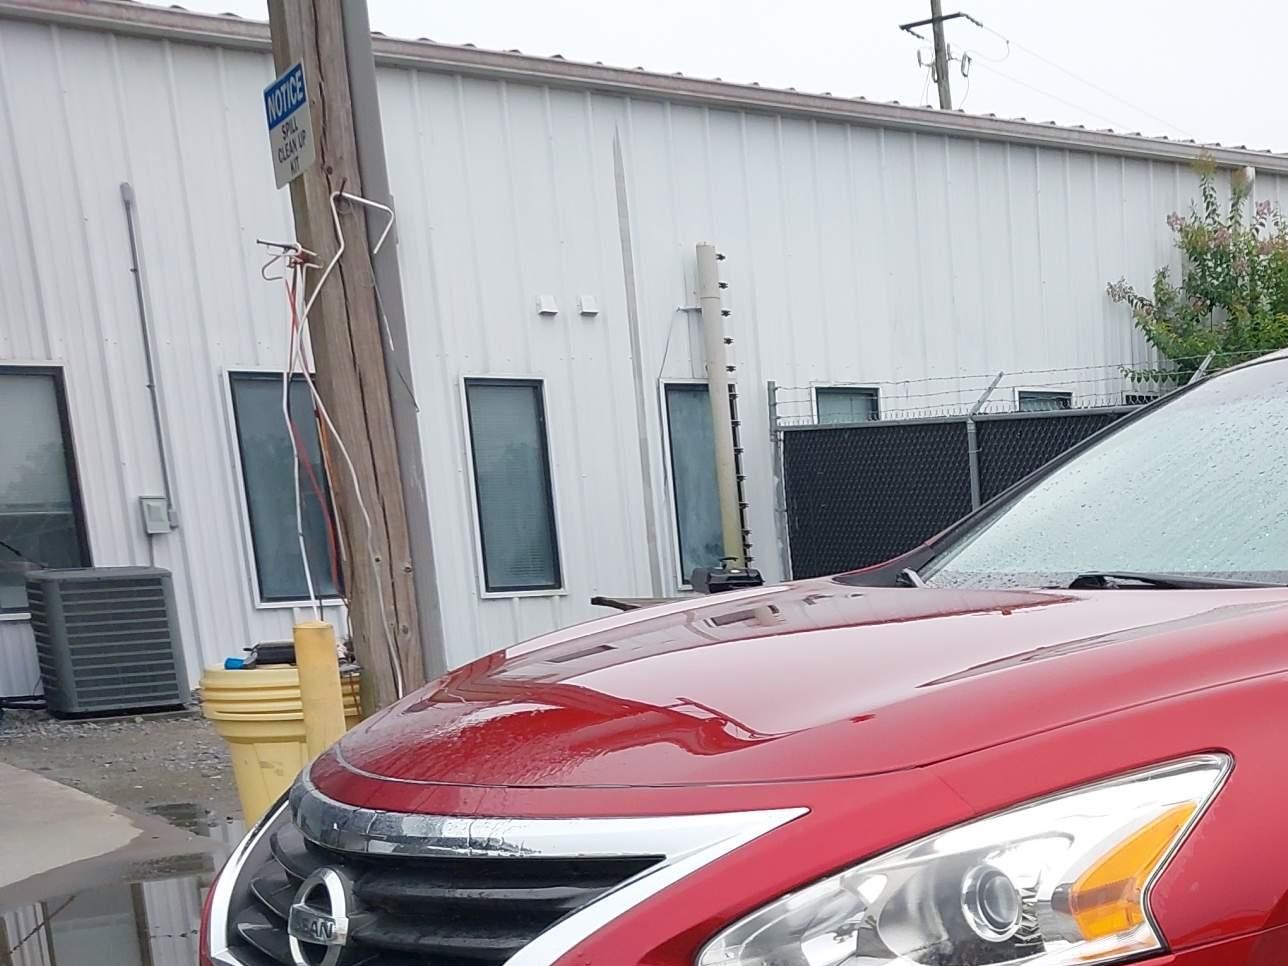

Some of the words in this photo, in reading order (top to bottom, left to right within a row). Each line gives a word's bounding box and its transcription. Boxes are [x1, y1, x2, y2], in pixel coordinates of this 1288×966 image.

[267, 70, 304, 124] NOTICE
[281, 115, 299, 141] SPILL
[277, 137, 298, 164] CLEAN
[297, 129, 306, 149] UP
